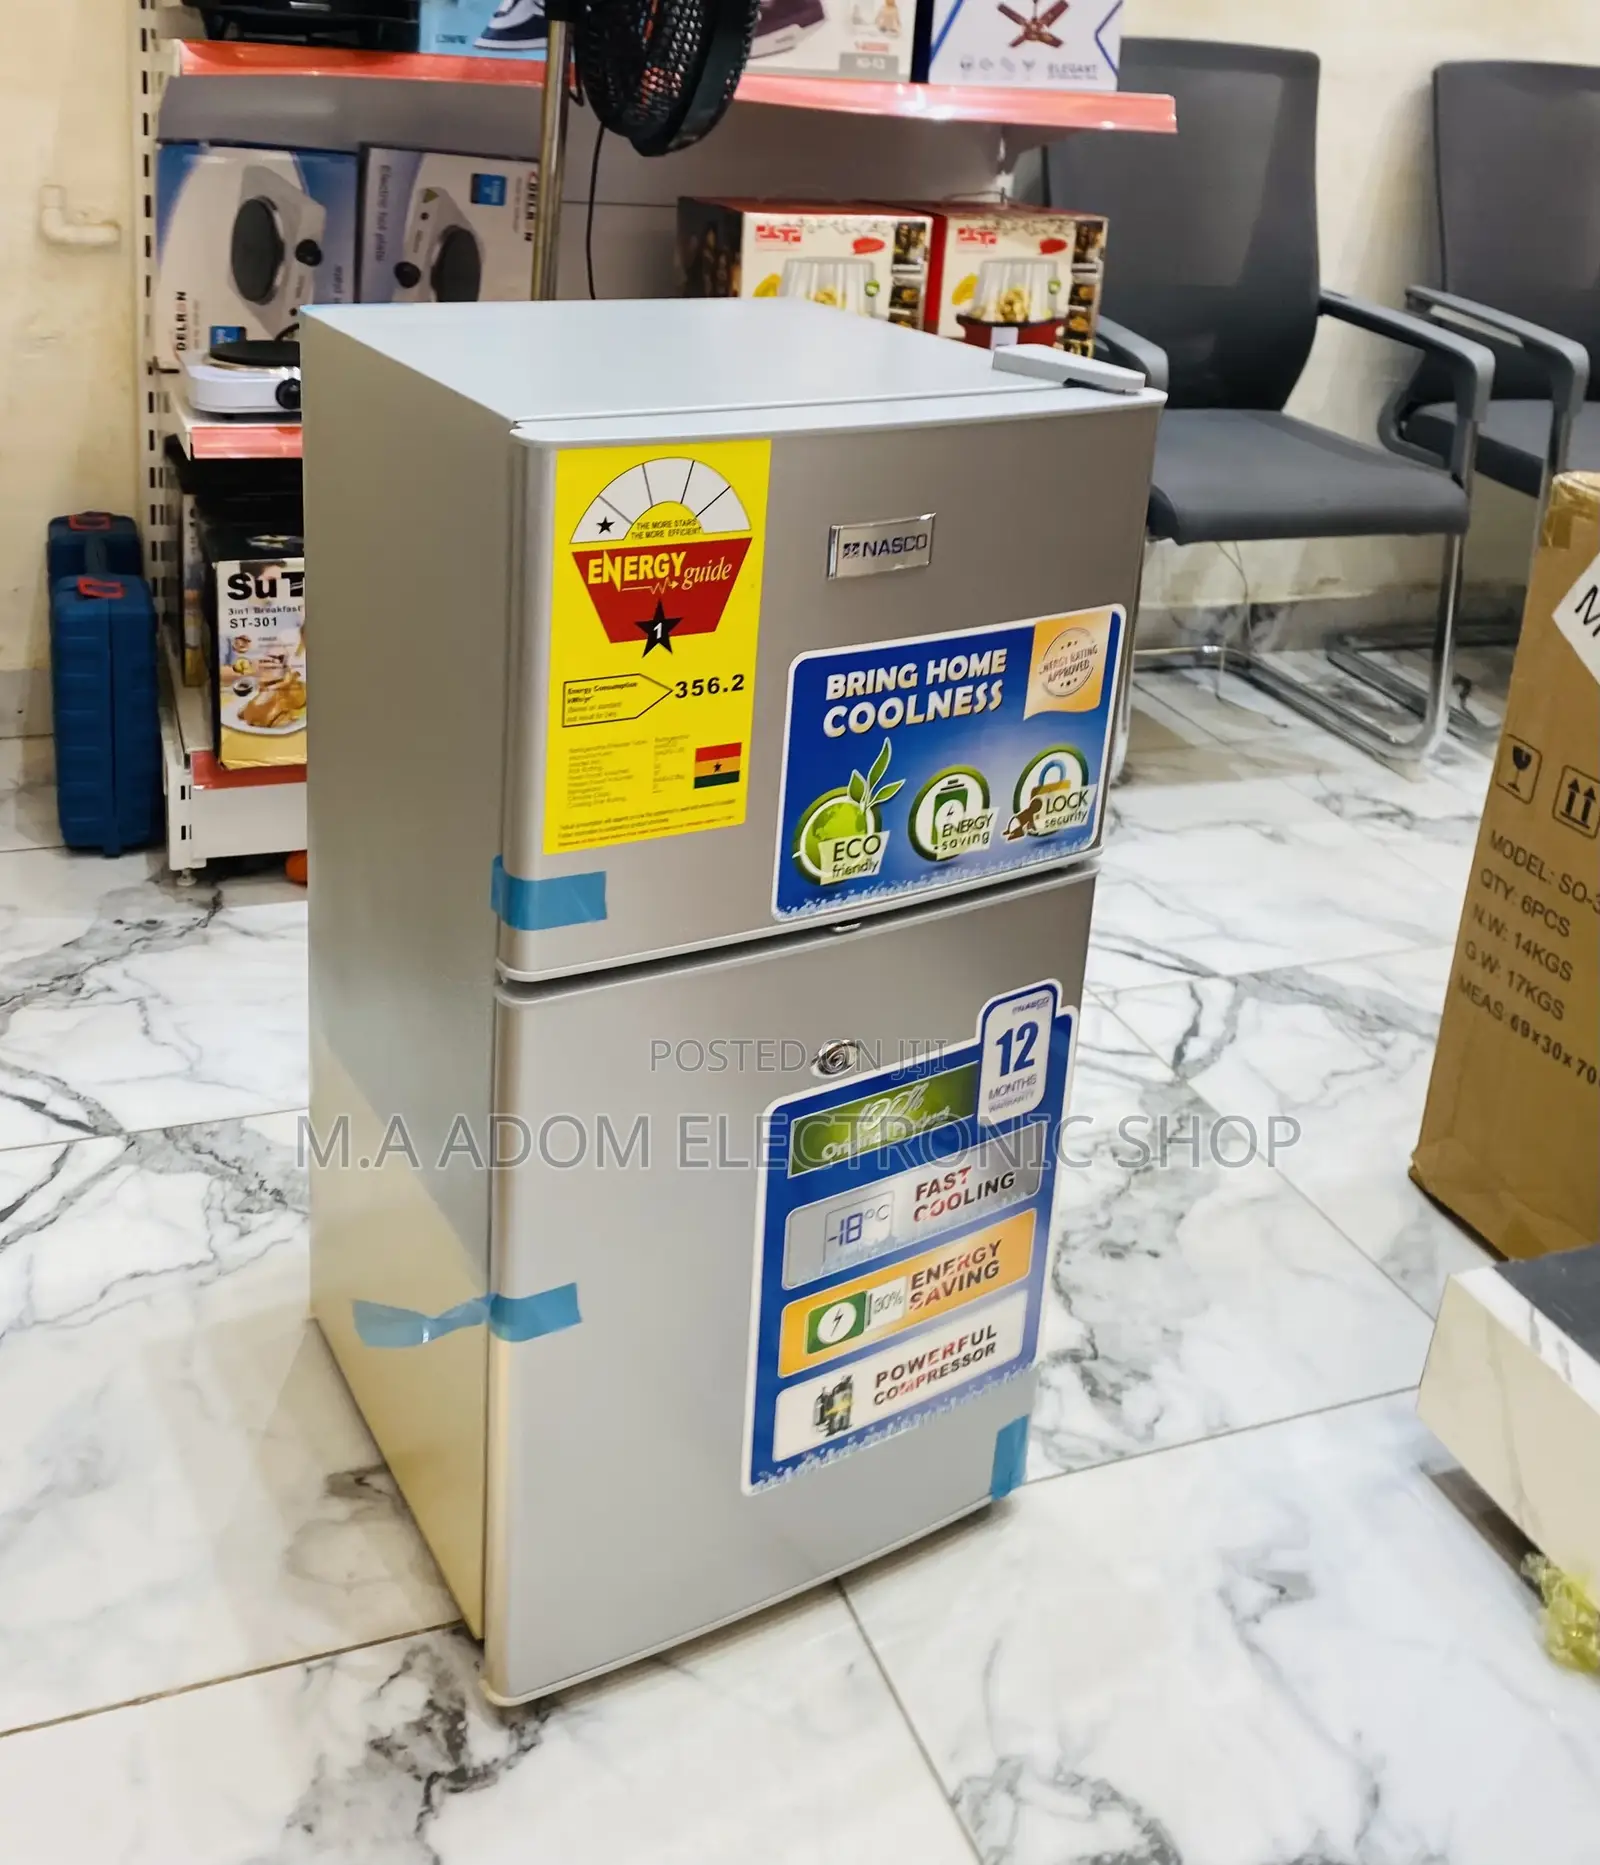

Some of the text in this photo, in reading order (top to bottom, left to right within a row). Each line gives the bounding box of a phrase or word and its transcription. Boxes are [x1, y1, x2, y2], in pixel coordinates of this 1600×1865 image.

[377, 211, 388, 232] hot
[631, 531, 645, 541] THE
[645, 529, 665, 539] MORE
[636, 518, 698, 531] THE MORE STARS
[862, 533, 929, 558] NASCO
[587, 550, 733, 593] ENERGY guide
[229, 616, 278, 630] ST-301
[652, 621, 663, 640] 1
[674, 673, 746, 700] 356.2
[825, 648, 1009, 702] BRING HOME
[822, 678, 1006, 739] COOLNESS
[1044, 788, 1089, 816] LOCK
[941, 811, 995, 839] ENERGY
[1043, 808, 1089, 830] security
[832, 834, 882, 863] ECO
[941, 830, 991, 852] saving
[831, 859, 880, 880] friendly
[1490, 829, 1555, 885] MODEL:
[1480, 867, 1571, 938] QTY: 6PCS
[1514, 931, 1575, 982] 14KGS
[1508, 969, 1566, 1022] 17KGS
[995, 1020, 1039, 1078] 12
[988, 1073, 1038, 1101] MONTHS
[913, 1170, 1016, 1223] COOLING
[914, 1165, 973, 1202] FAST
[910, 1239, 1003, 1291] ENERGY
[908, 1260, 1001, 1311] SAVING
[873, 1291, 905, 1315] 30%
[874, 1324, 998, 1389] POWERFUL
[872, 1341, 997, 1406] COMPRESSOR
